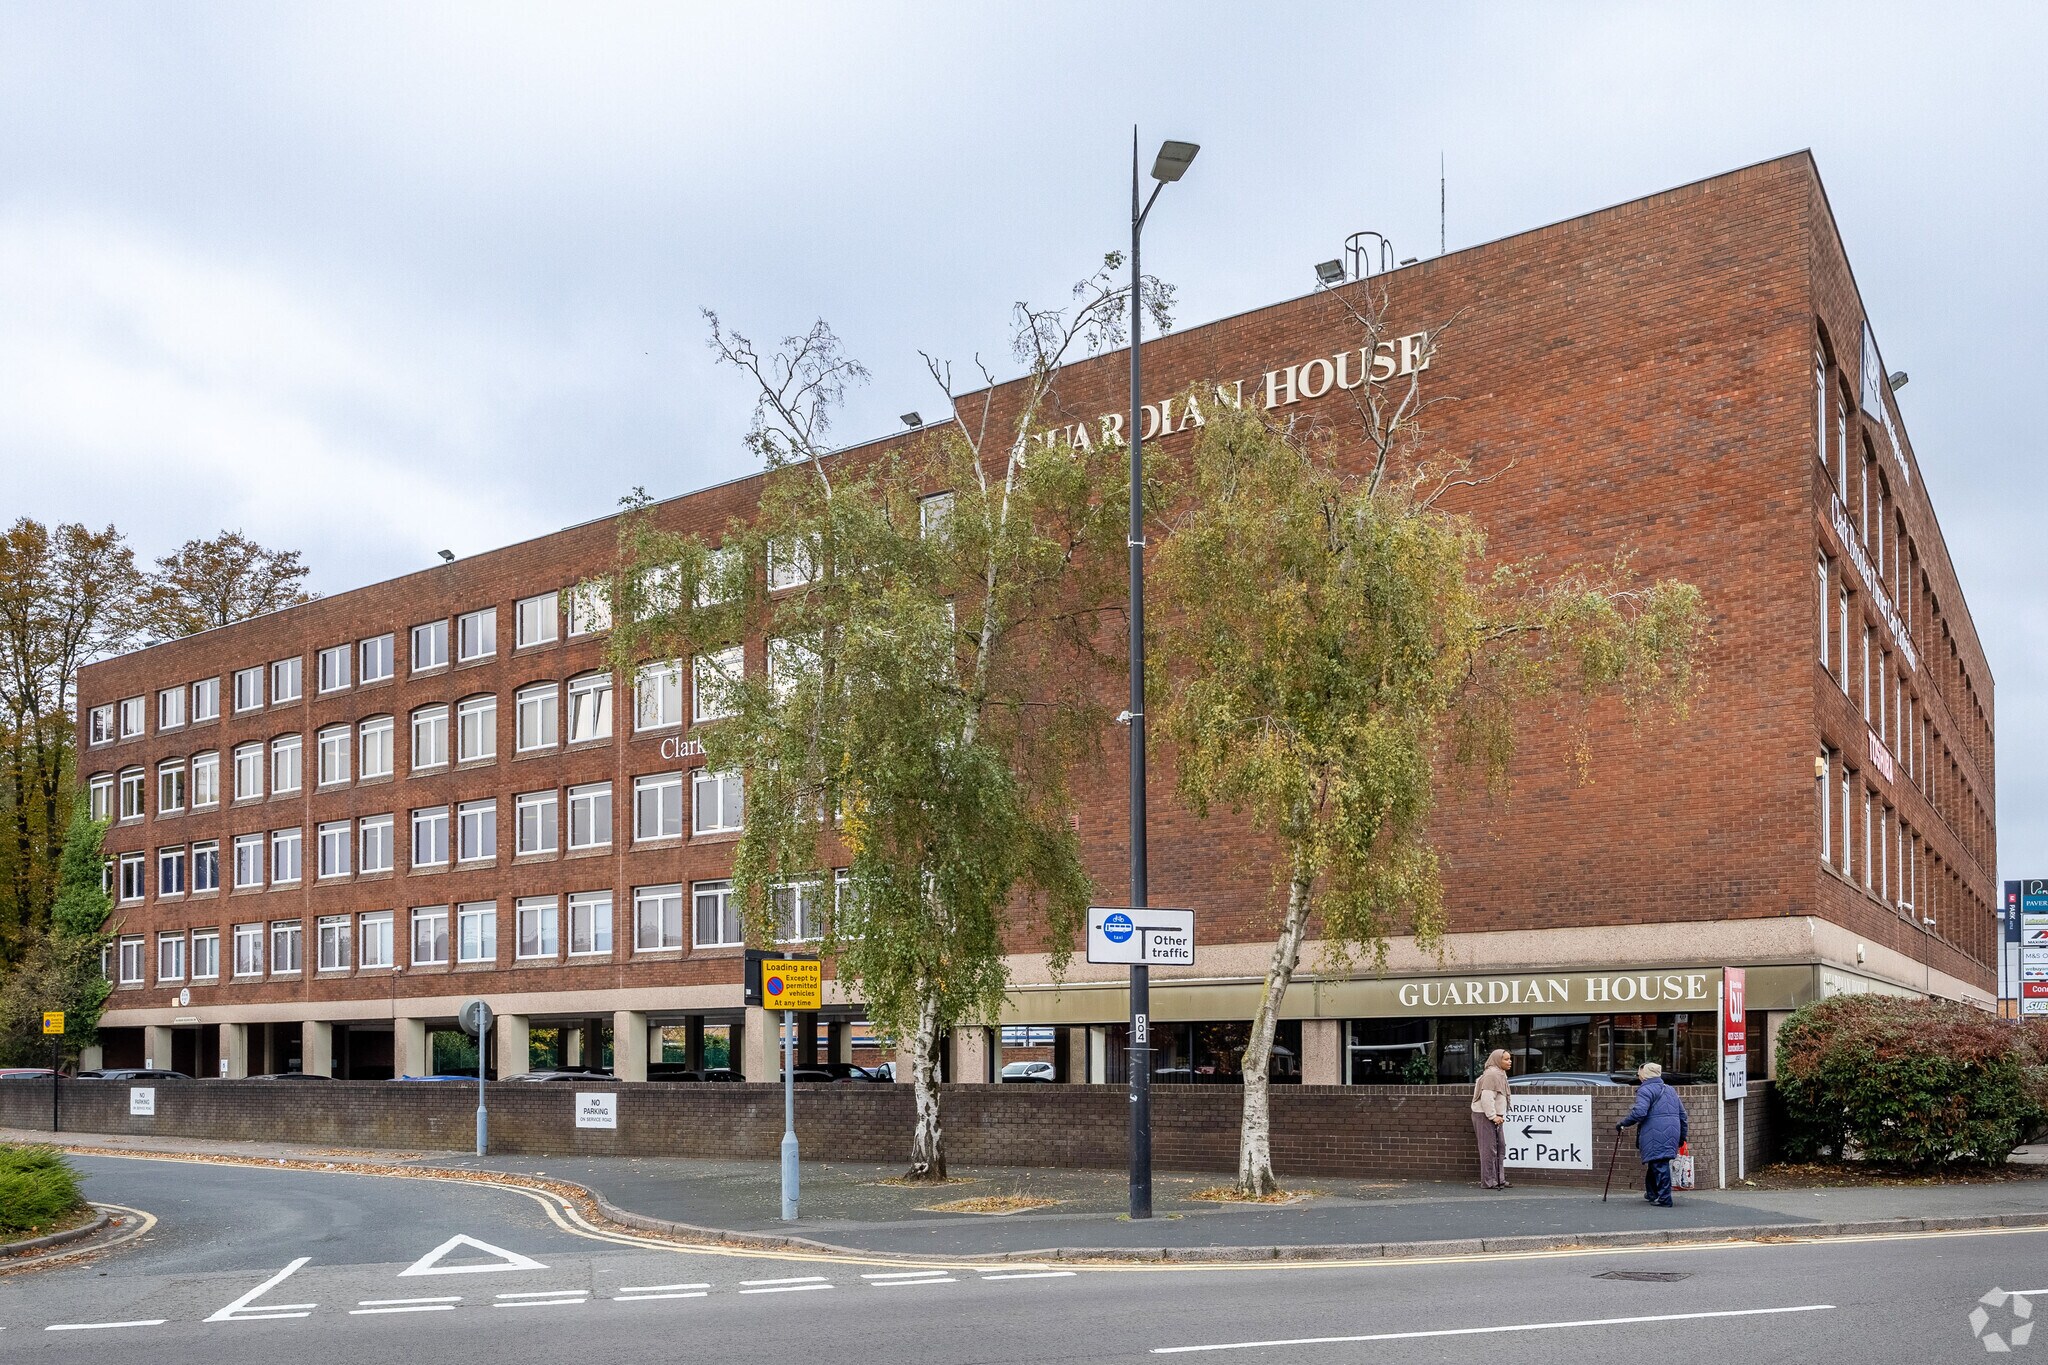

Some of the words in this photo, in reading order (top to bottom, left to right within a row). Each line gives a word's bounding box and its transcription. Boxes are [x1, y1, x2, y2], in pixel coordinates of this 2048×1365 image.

[1263, 331, 1432, 410] HOUSE
[1868, 729, 1894, 786] TOSHIBA
[1154, 935, 1188, 946] Other
[1152, 947, 1189, 958] traffic
[766, 963, 798, 972] Loading
[786, 974, 808, 982] Except
[809, 974, 818, 983] by
[786, 982, 818, 990] permitted
[1398, 977, 1570, 1007] GUARDIAN
[1585, 974, 1708, 1003] HOUSE
[2027, 1001, 2048, 1010] SUB
[1137, 1016, 1145, 1042] 004
[1729, 1071, 1736, 1089] TO
[1736, 1070, 1744, 1088] LET
[592, 1099, 601, 1107] NO
[583, 1107, 609, 1115] PARKING
[1508, 1104, 1545, 1113] ARDIAN
[1548, 1104, 1584, 1113] HOUSE
[1505, 1114, 1535, 1123] STAFF
[1537, 1114, 1566, 1123] ONLY
[1504, 1145, 1529, 1161] ar
[1536, 1143, 1582, 1162] Park
